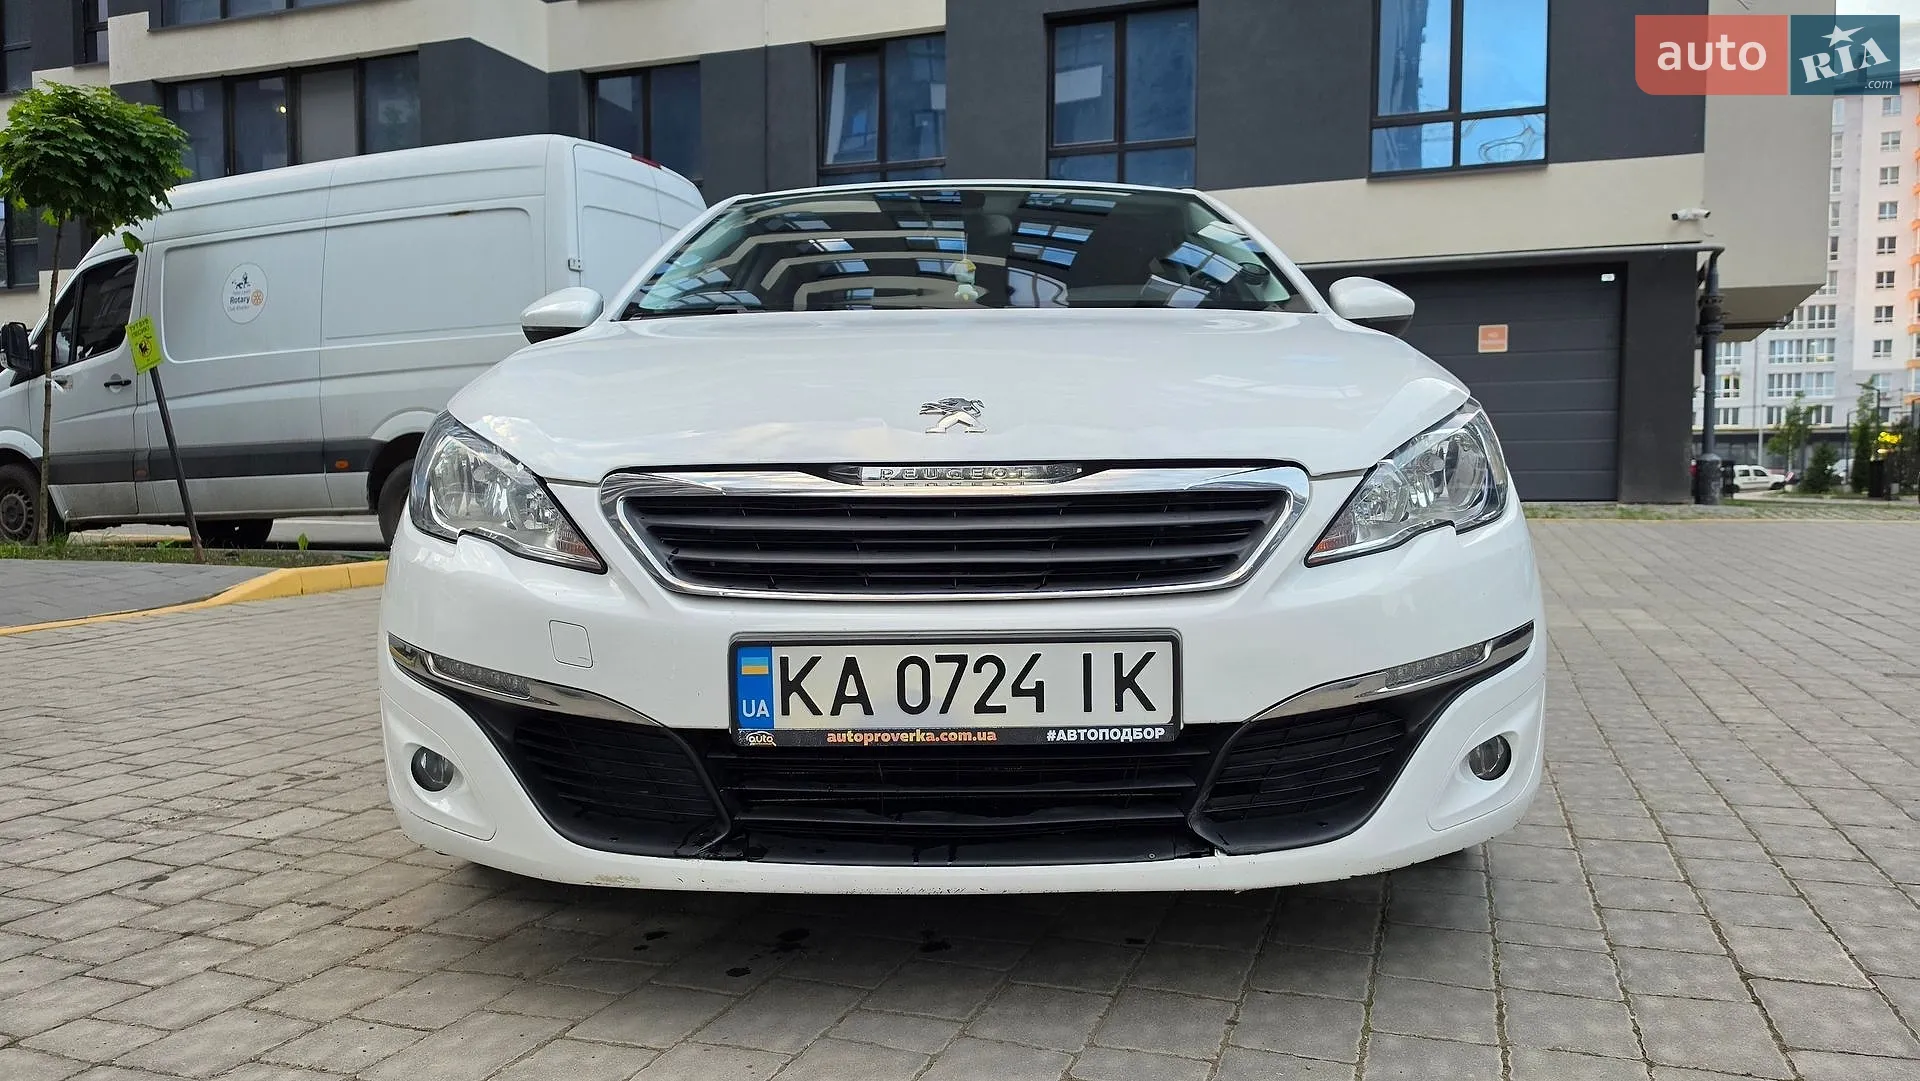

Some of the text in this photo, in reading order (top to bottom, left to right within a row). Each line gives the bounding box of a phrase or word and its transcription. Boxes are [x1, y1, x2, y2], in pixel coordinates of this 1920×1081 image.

[230, 296, 250, 305] Rotary
[880, 467, 1027, 481] PEUGEOT
[778, 651, 1157, 718] KA 0724 IK
[742, 699, 770, 718] UA
[748, 735, 774, 743] auto
[826, 729, 998, 746] autoproverka.com.ua
[1046, 728, 1166, 743] #АВТОПОДБОР
